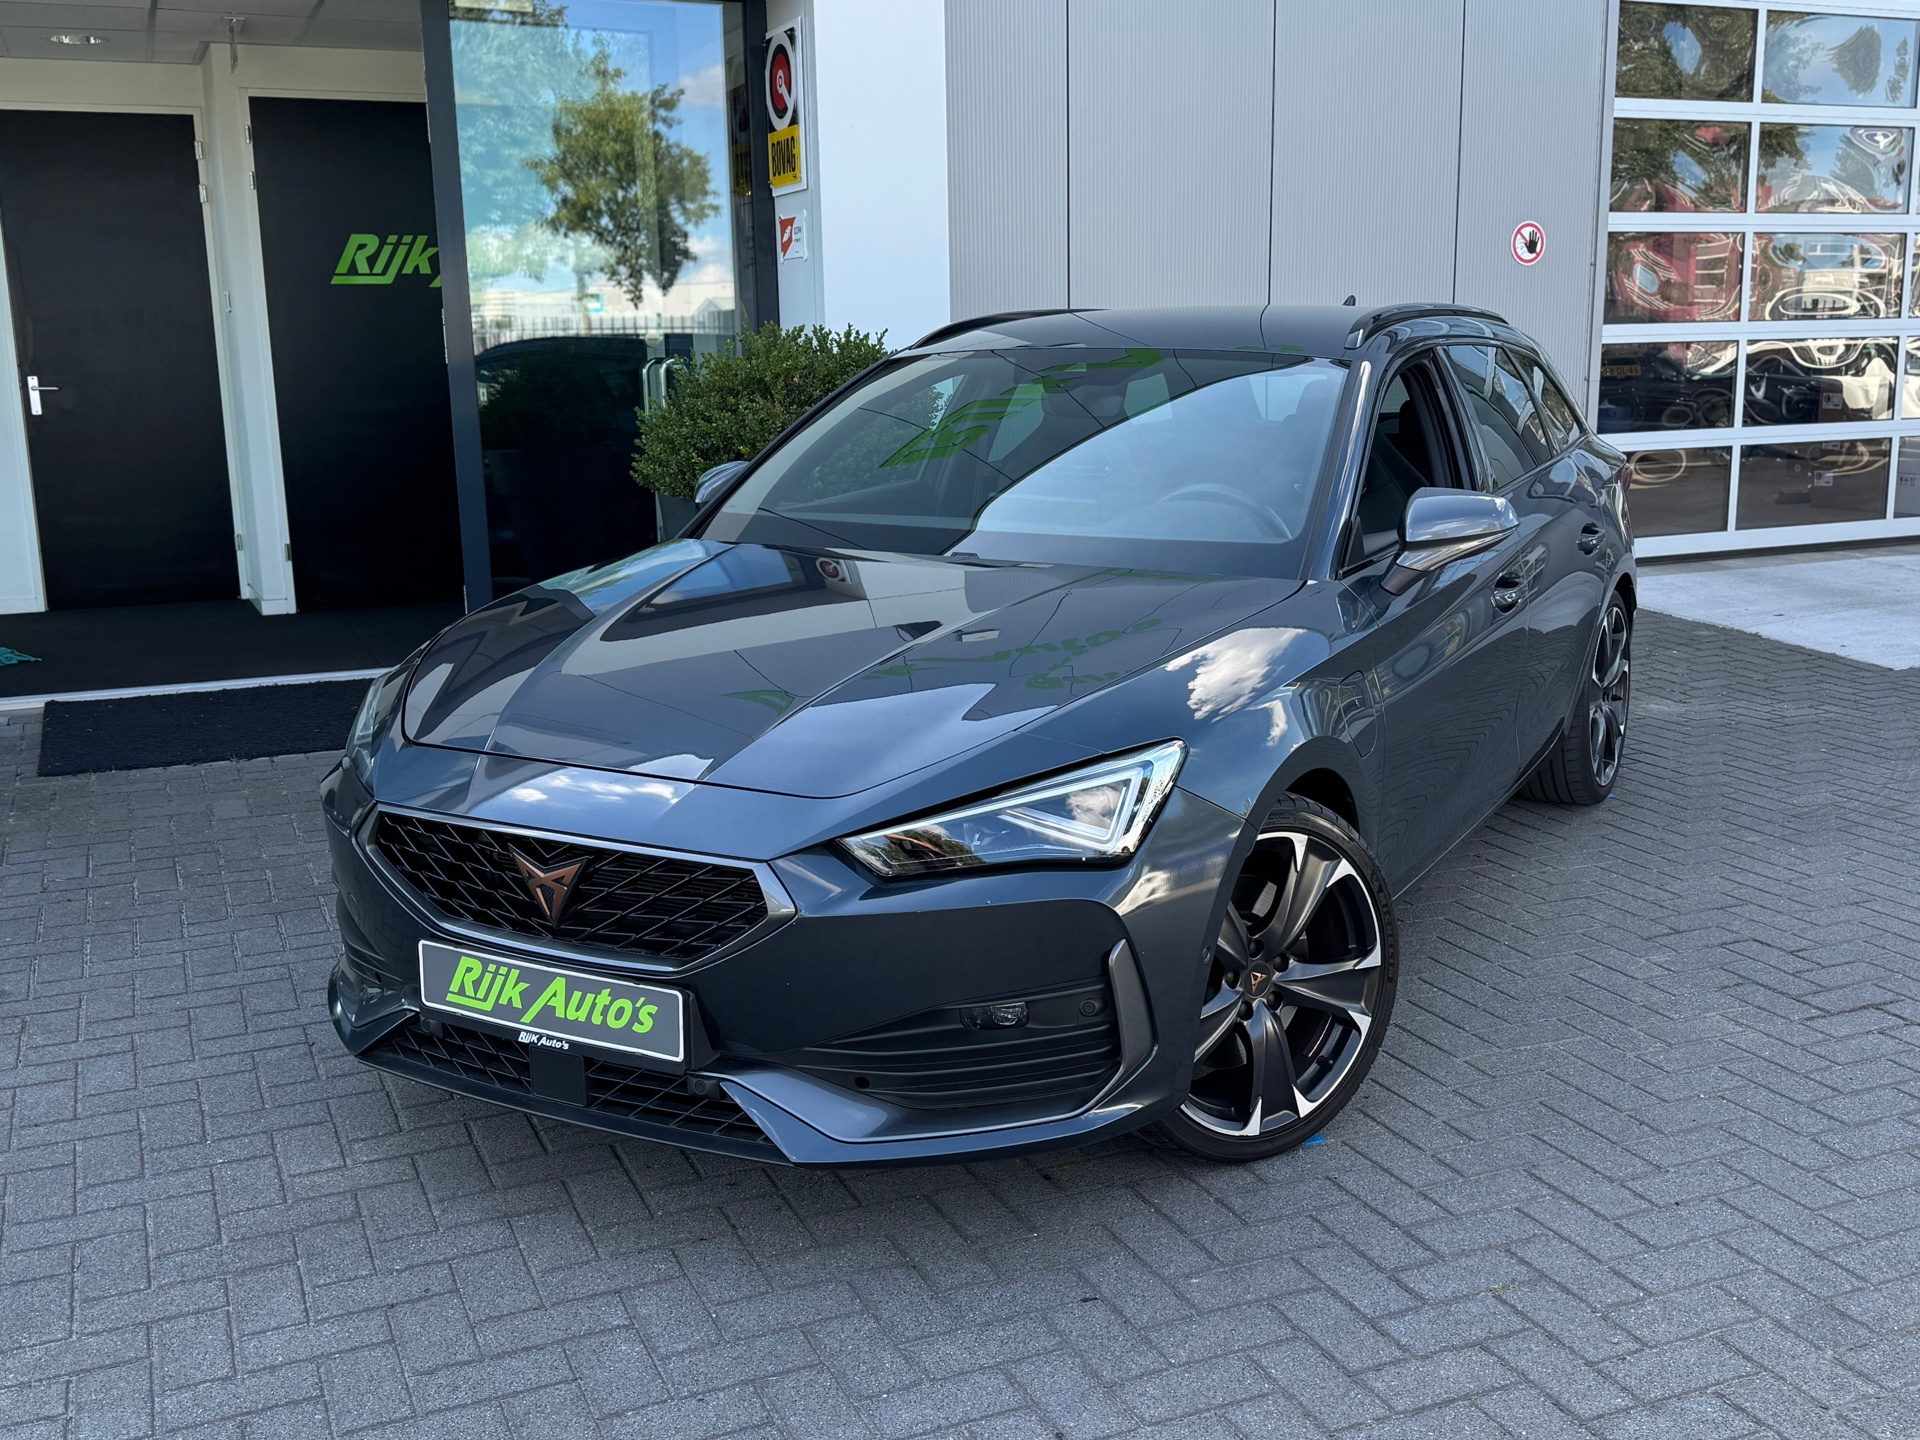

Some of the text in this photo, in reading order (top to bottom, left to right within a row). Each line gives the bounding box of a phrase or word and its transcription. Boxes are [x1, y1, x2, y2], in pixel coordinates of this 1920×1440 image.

[771, 135, 796, 178] BOVAG
[330, 233, 440, 285] Rijk
[446, 956, 658, 1034] Rijk Auto's
[537, 1036, 570, 1050] Auto's
